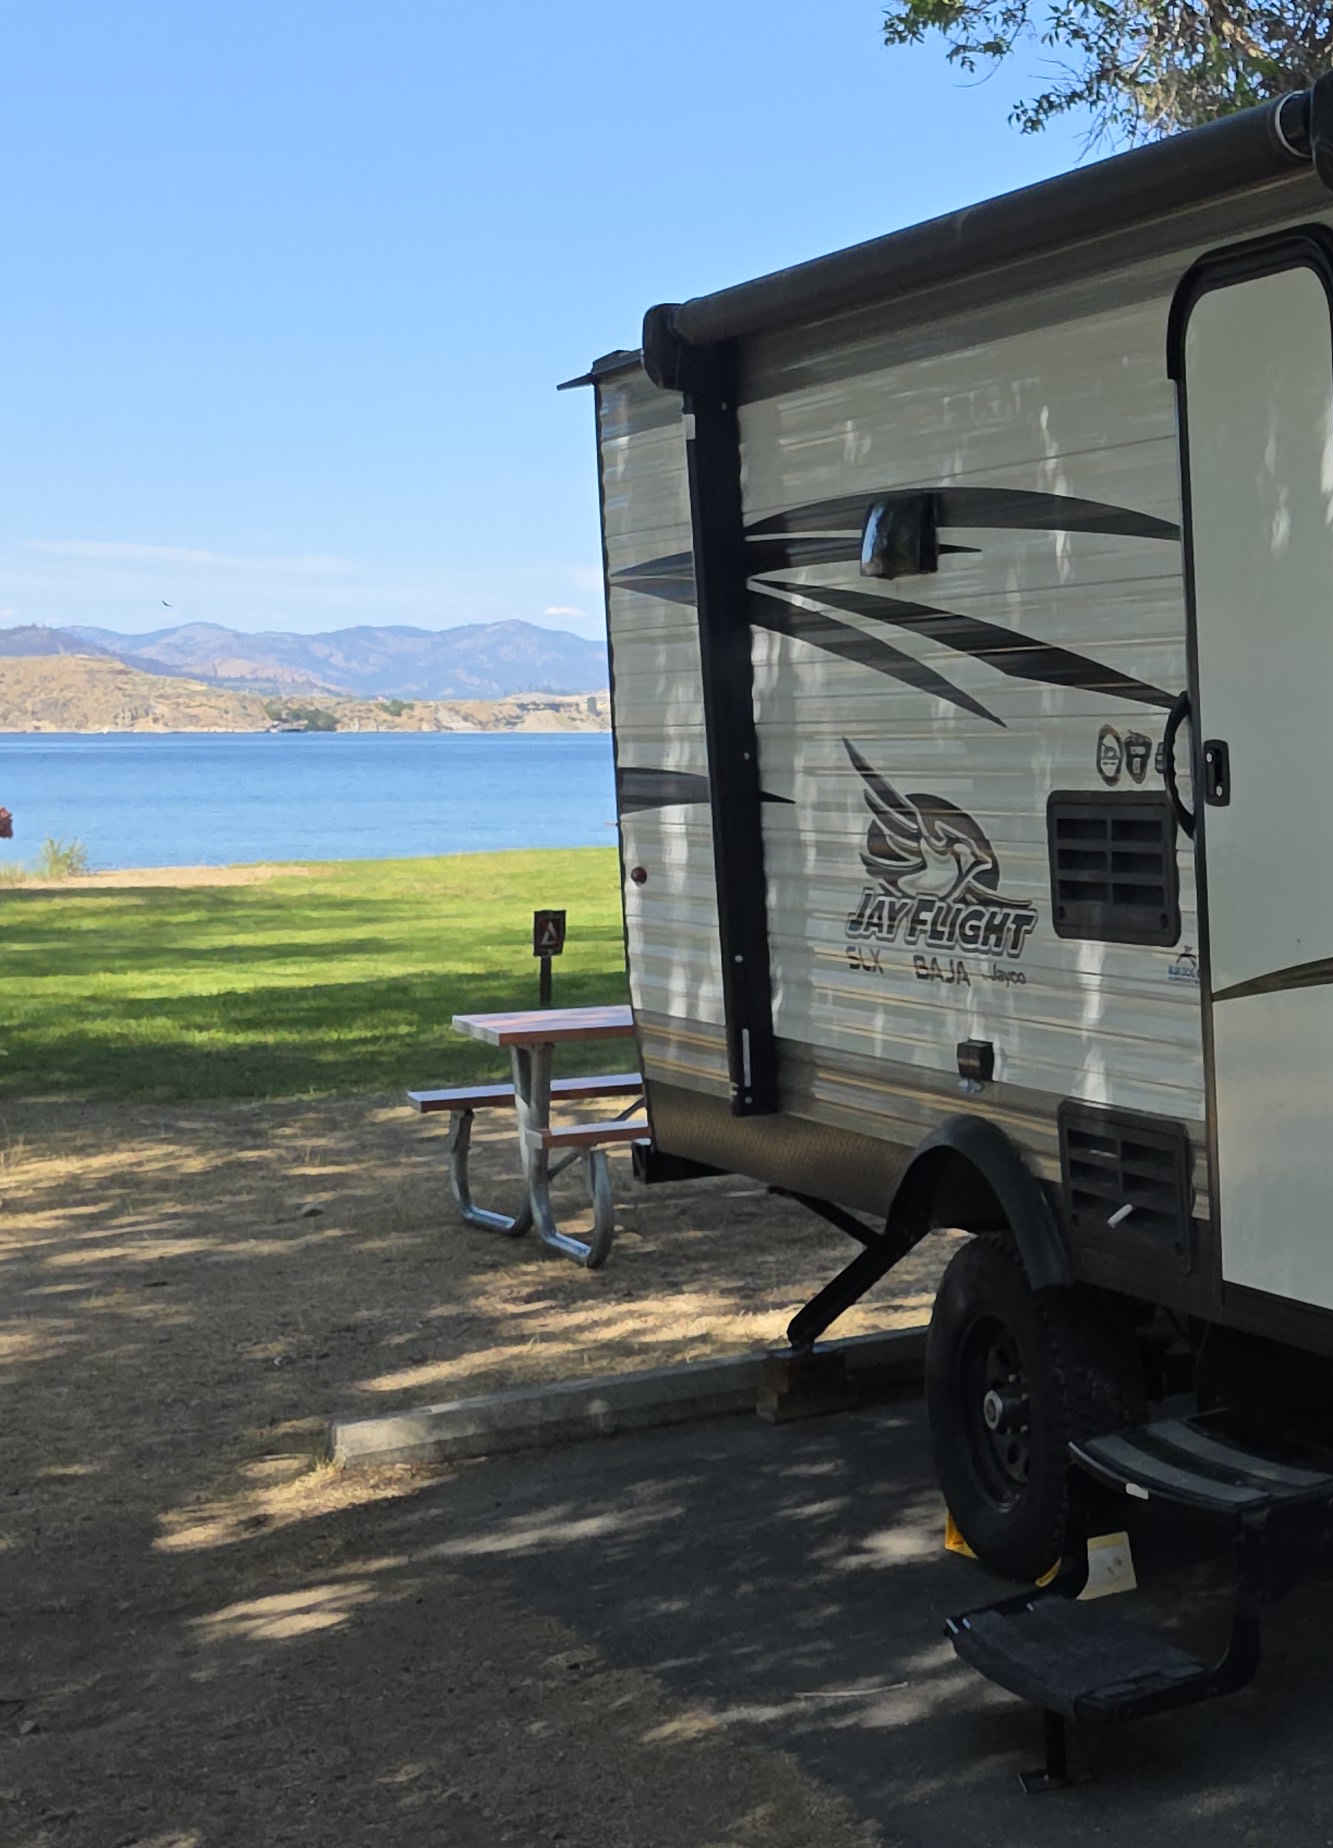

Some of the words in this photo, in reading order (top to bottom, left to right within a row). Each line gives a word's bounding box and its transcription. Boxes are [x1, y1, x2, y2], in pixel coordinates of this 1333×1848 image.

[845, 887, 911, 942] JAY
[904, 892, 1038, 958] FLIGHT
[845, 946, 885, 975] SLX
[913, 954, 972, 987] BAJA
